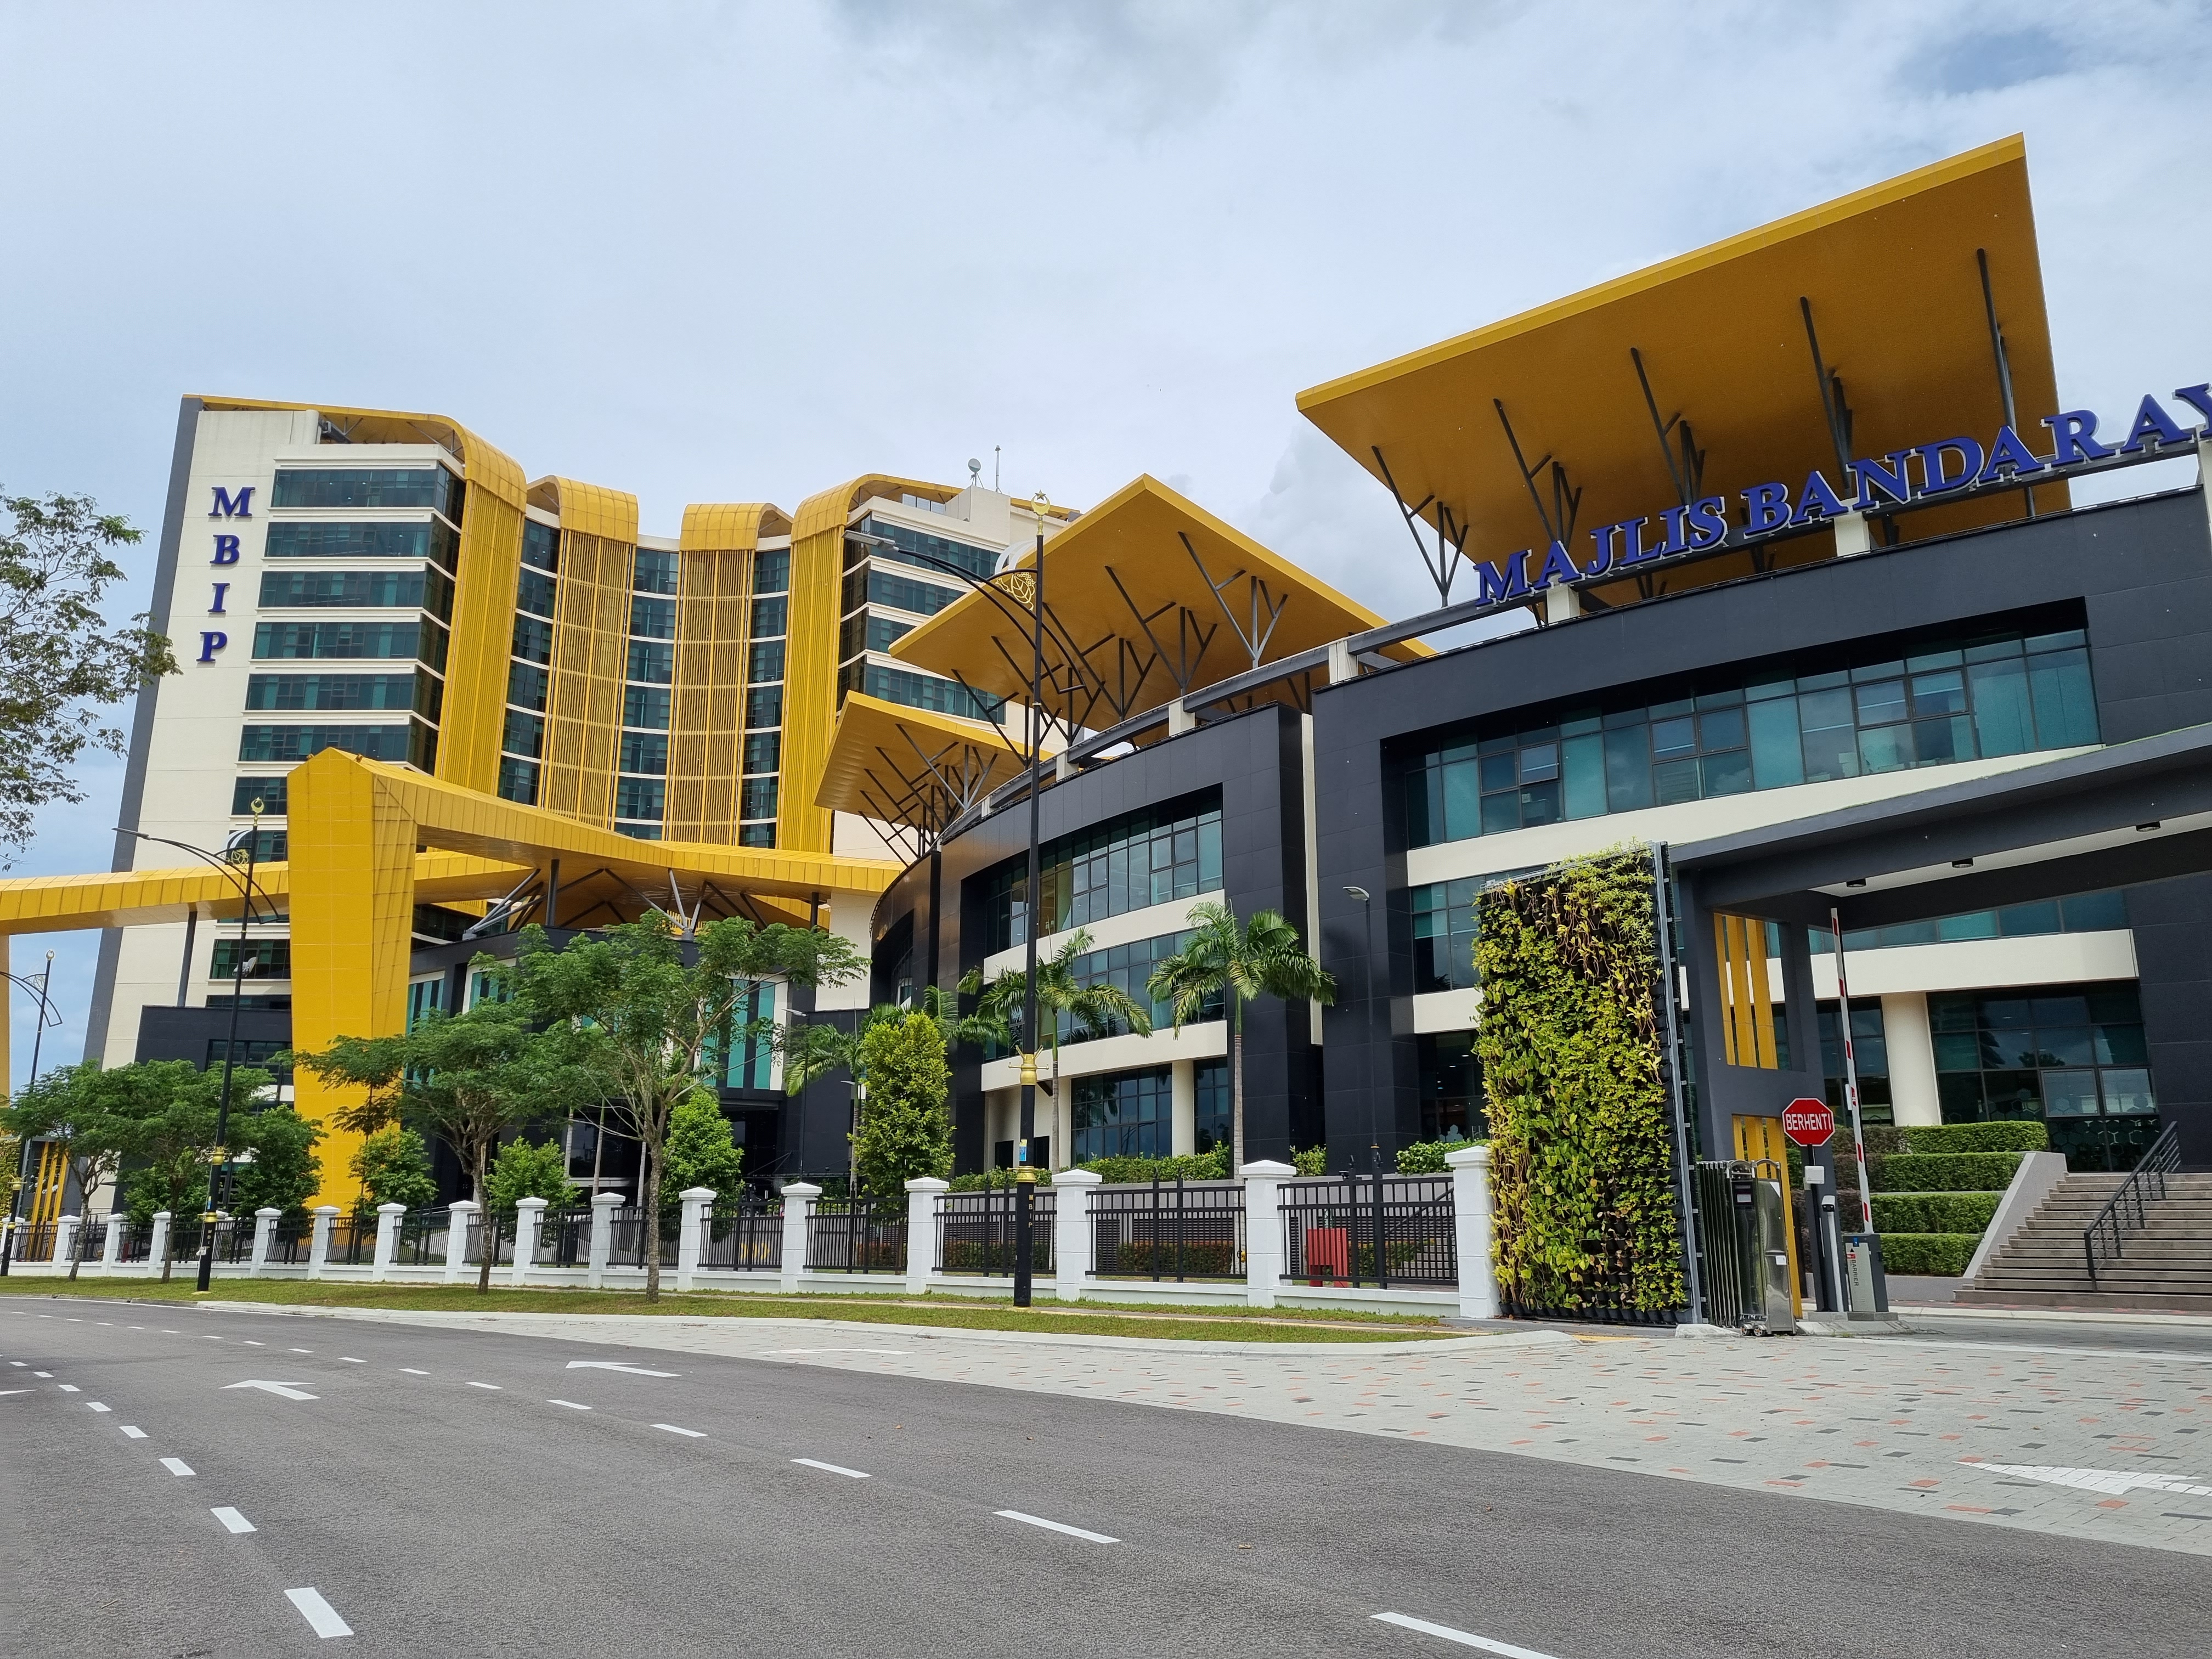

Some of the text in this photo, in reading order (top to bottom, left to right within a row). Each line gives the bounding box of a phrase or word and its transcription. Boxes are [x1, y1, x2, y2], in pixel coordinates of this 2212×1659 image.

[196, 487, 256, 662] MBIP
[1473, 496, 1725, 608] MAJLIS
[1785, 1113, 1832, 1130] BERHENTI
[1851, 1260, 1859, 1286] BARRIER
